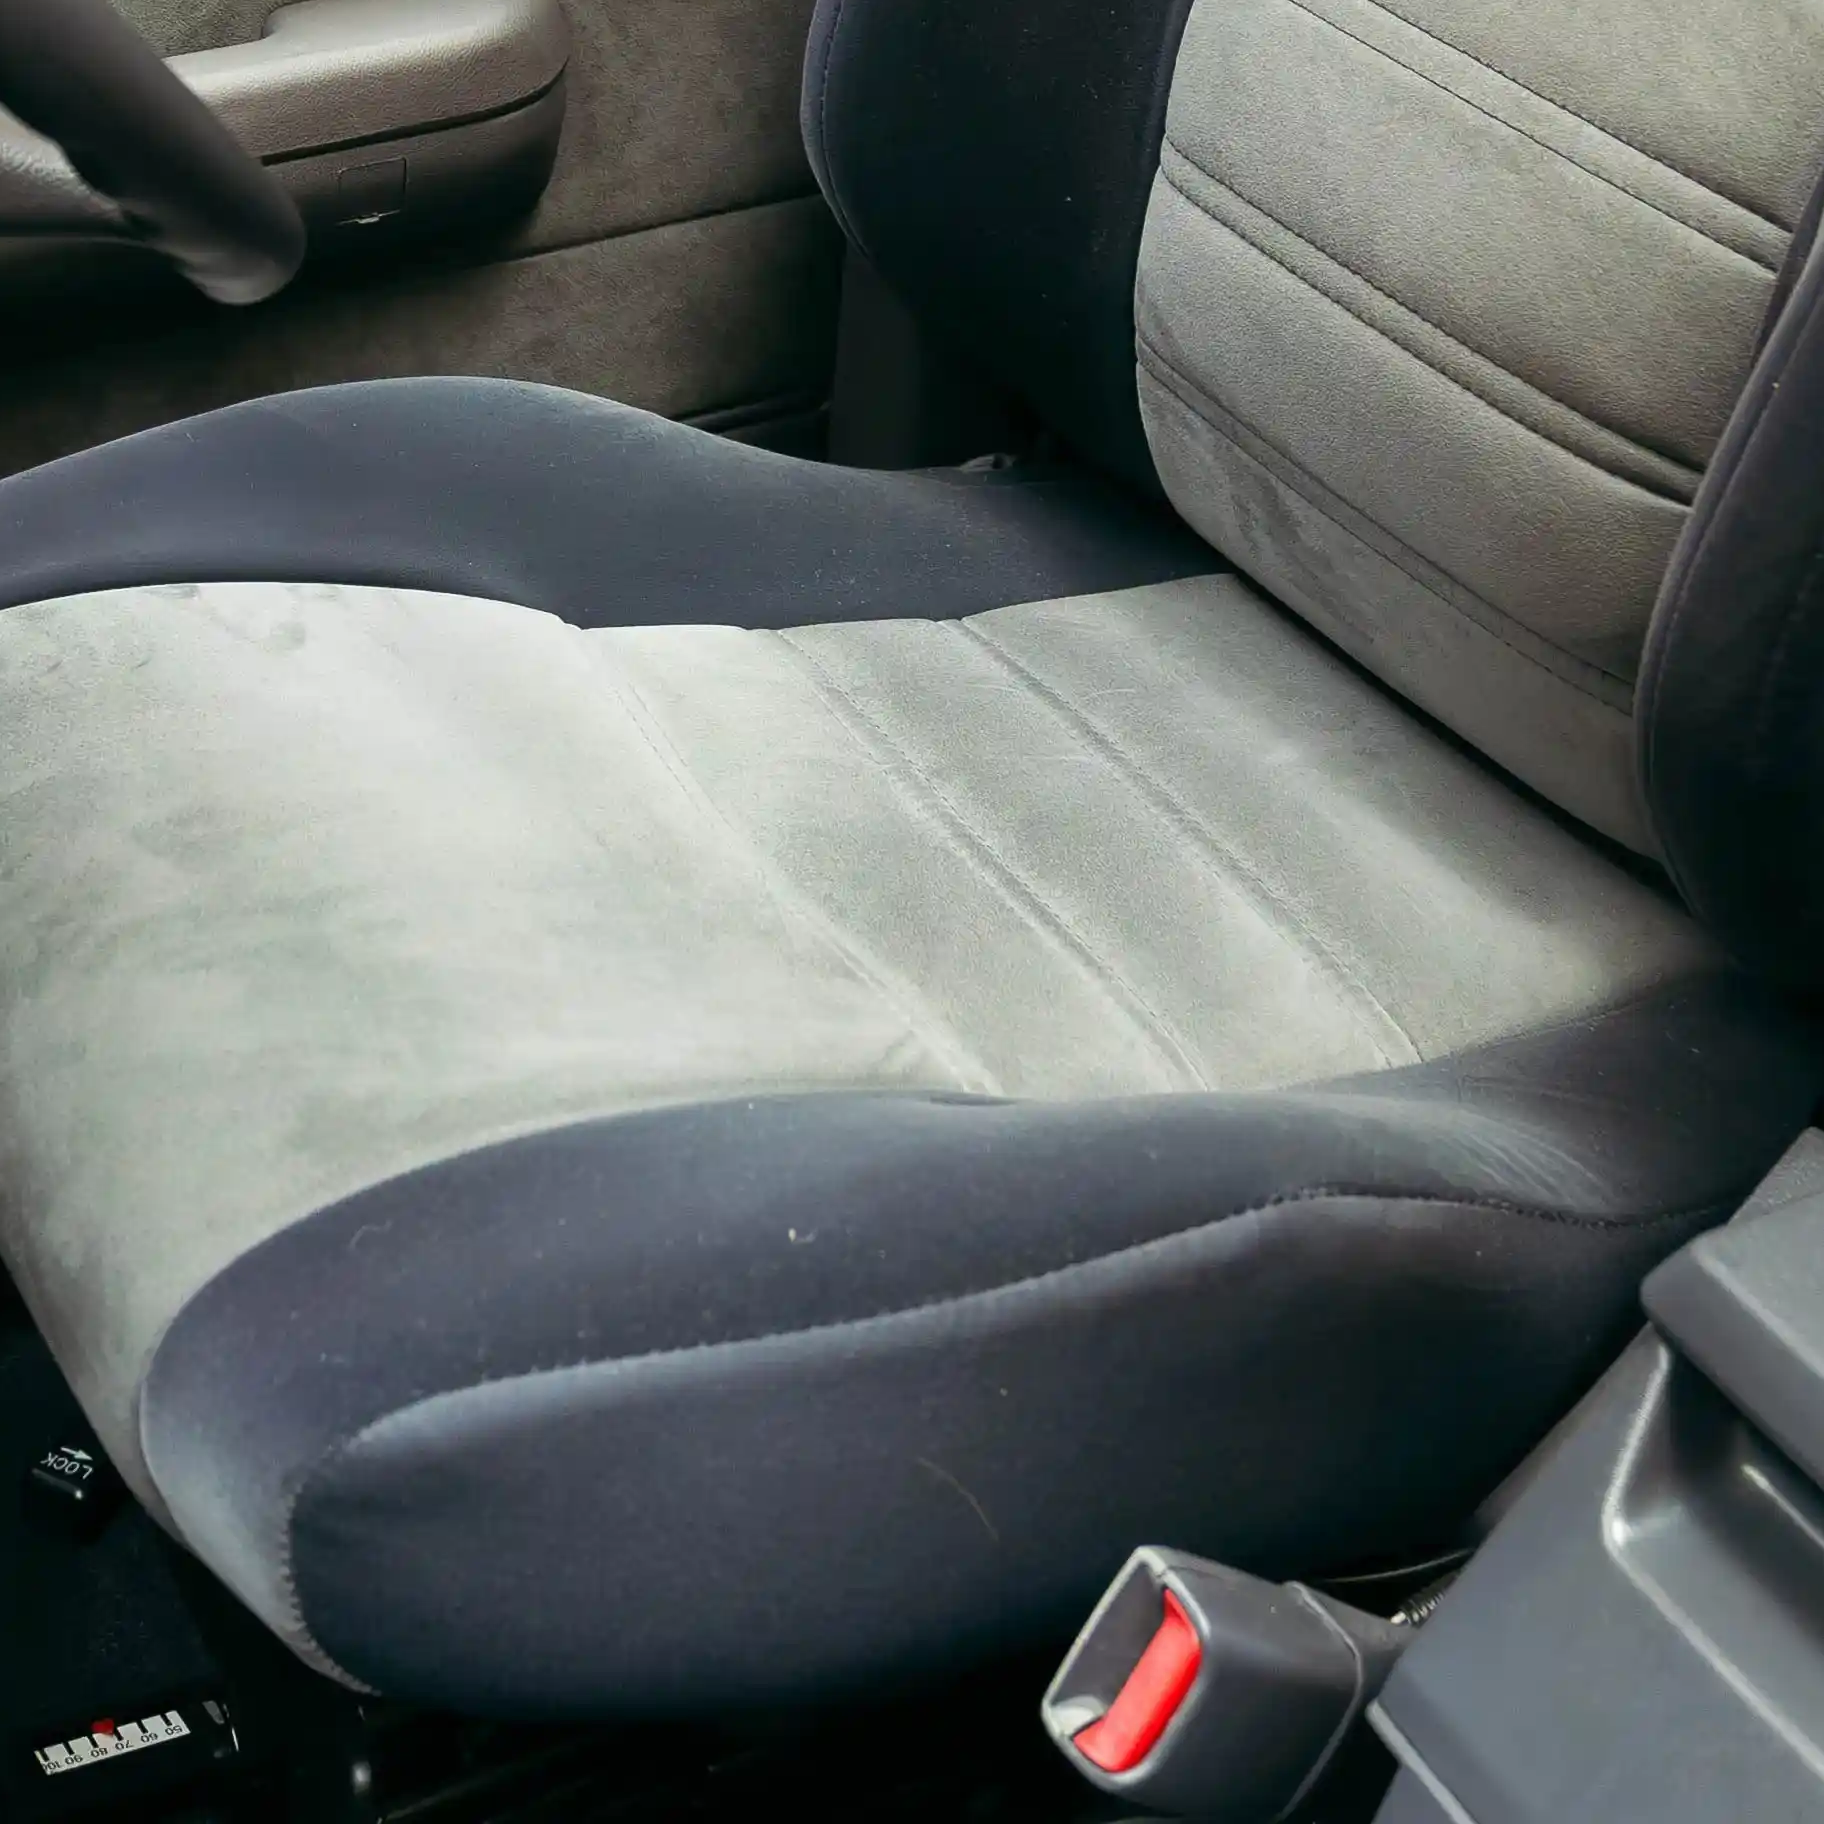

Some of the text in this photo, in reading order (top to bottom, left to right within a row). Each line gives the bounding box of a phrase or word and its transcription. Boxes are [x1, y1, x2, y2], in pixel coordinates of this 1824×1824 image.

[40, 1452, 93, 1479] LOCK
[164, 1725, 183, 1736] 50
[140, 1732, 159, 1743] 60
[115, 1739, 134, 1750] 70
[90, 1747, 109, 1758] 80
[64, 1754, 83, 1765] 90
